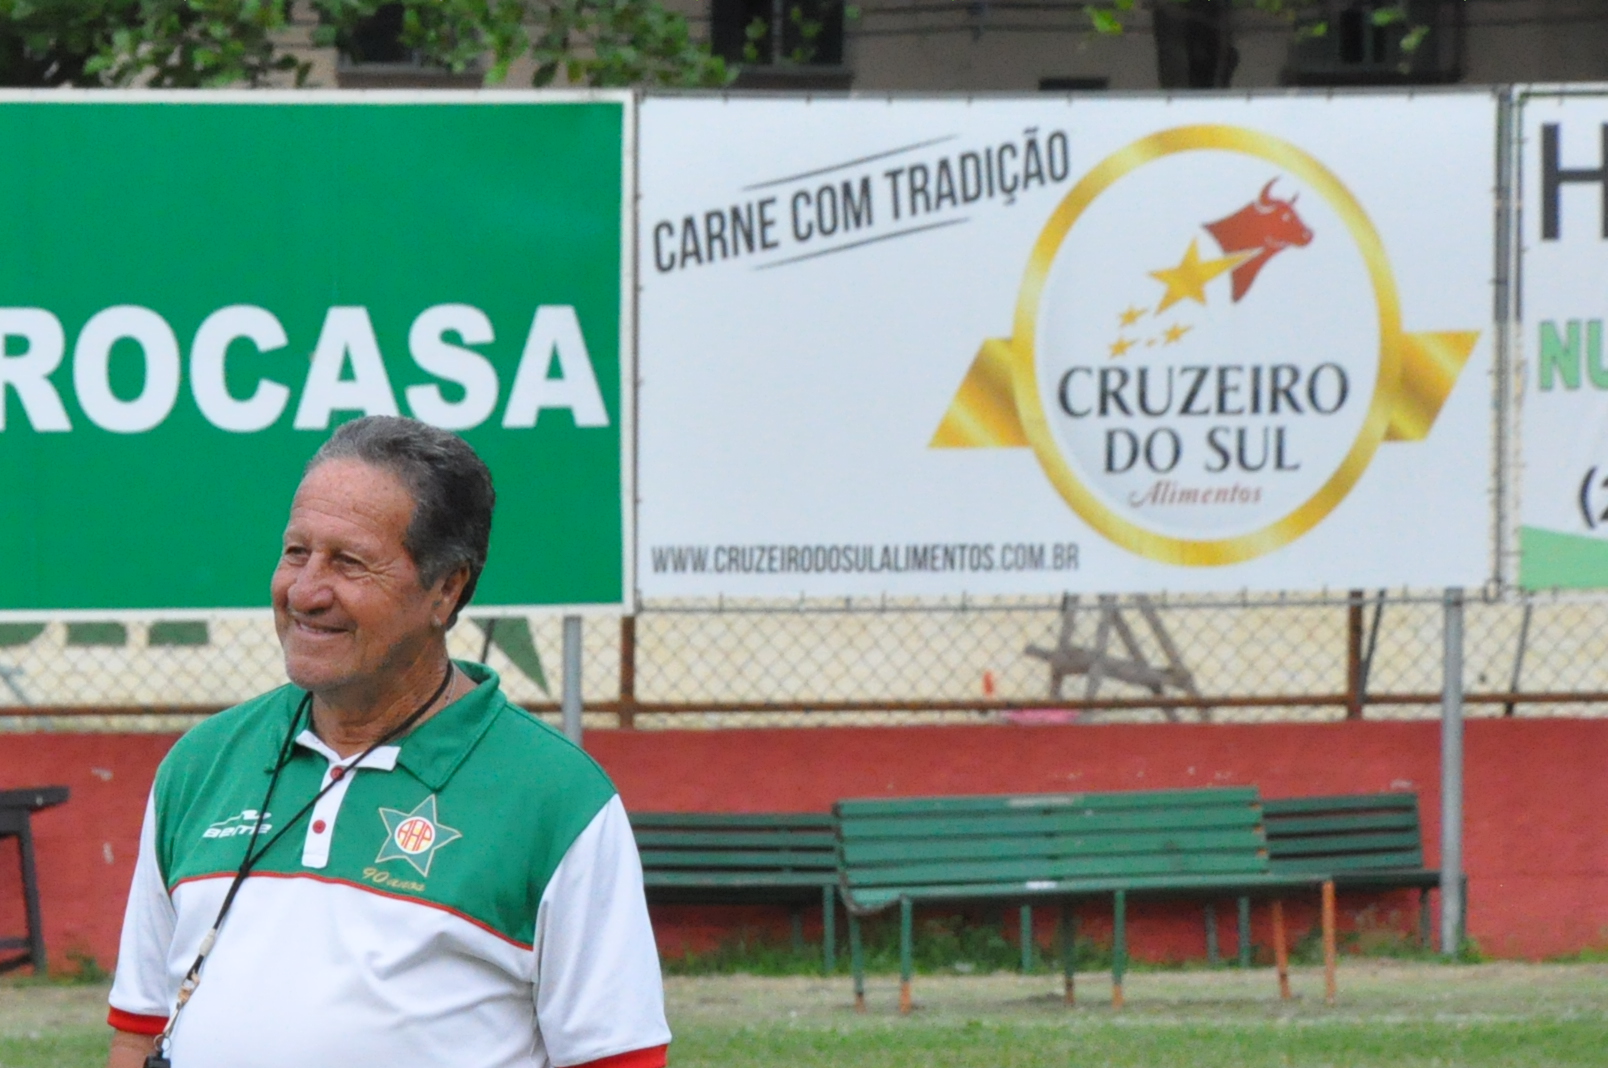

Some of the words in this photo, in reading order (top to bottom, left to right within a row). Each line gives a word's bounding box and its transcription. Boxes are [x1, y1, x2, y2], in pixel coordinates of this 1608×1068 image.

[653, 198, 779, 273] CARNE
[792, 175, 873, 242] COM
[884, 127, 1070, 220] TRADIÇÃO
[1057, 362, 1350, 419] CRUZEIRO
[1105, 427, 1182, 474] DO
[1205, 425, 1301, 473] SUL
[1128, 480, 1262, 508] Alimentos
[651, 542, 1080, 575] WWW.CRUZEIRODOSULALIMENTOS.COM.BR
